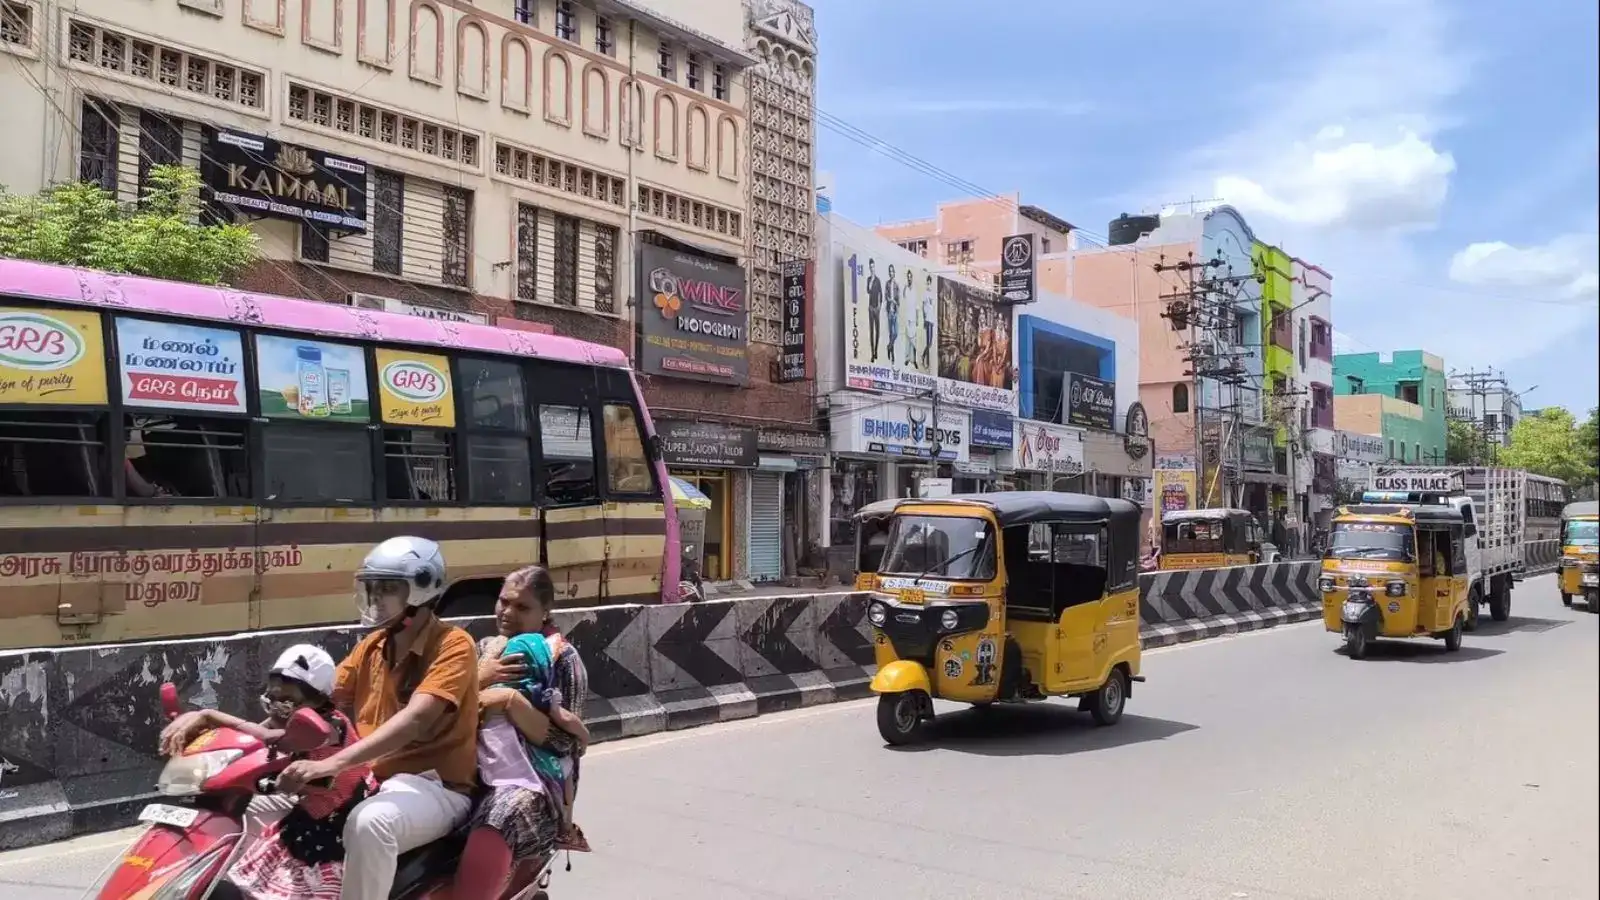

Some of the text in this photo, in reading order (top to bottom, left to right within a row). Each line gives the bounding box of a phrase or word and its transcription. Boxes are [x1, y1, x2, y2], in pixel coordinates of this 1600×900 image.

[228, 163, 355, 211] KAMAAL
[677, 277, 742, 312] WINZ
[678, 316, 742, 340] PHOTOGRAPHY
[852, 307, 860, 359] FLOOR
[0, 325, 66, 355] GRB
[143, 336, 219, 356] மணல்
[125, 354, 237, 375] மணலாய்
[21, 376, 34, 392] of
[38, 373, 74, 390] purity
[137, 378, 232, 401] GRB நெய்
[393, 370, 437, 392] GRB
[389, 405, 442, 419] Sign of purity
[863, 417, 911, 440] BHIMA
[925, 427, 961, 445] BOYS
[661, 436, 687, 452] SUPER
[1375, 478, 1448, 490] GLASS PALACE
[0, 553, 61, 580] அரசு
[125, 579, 202, 608] மதுரை
